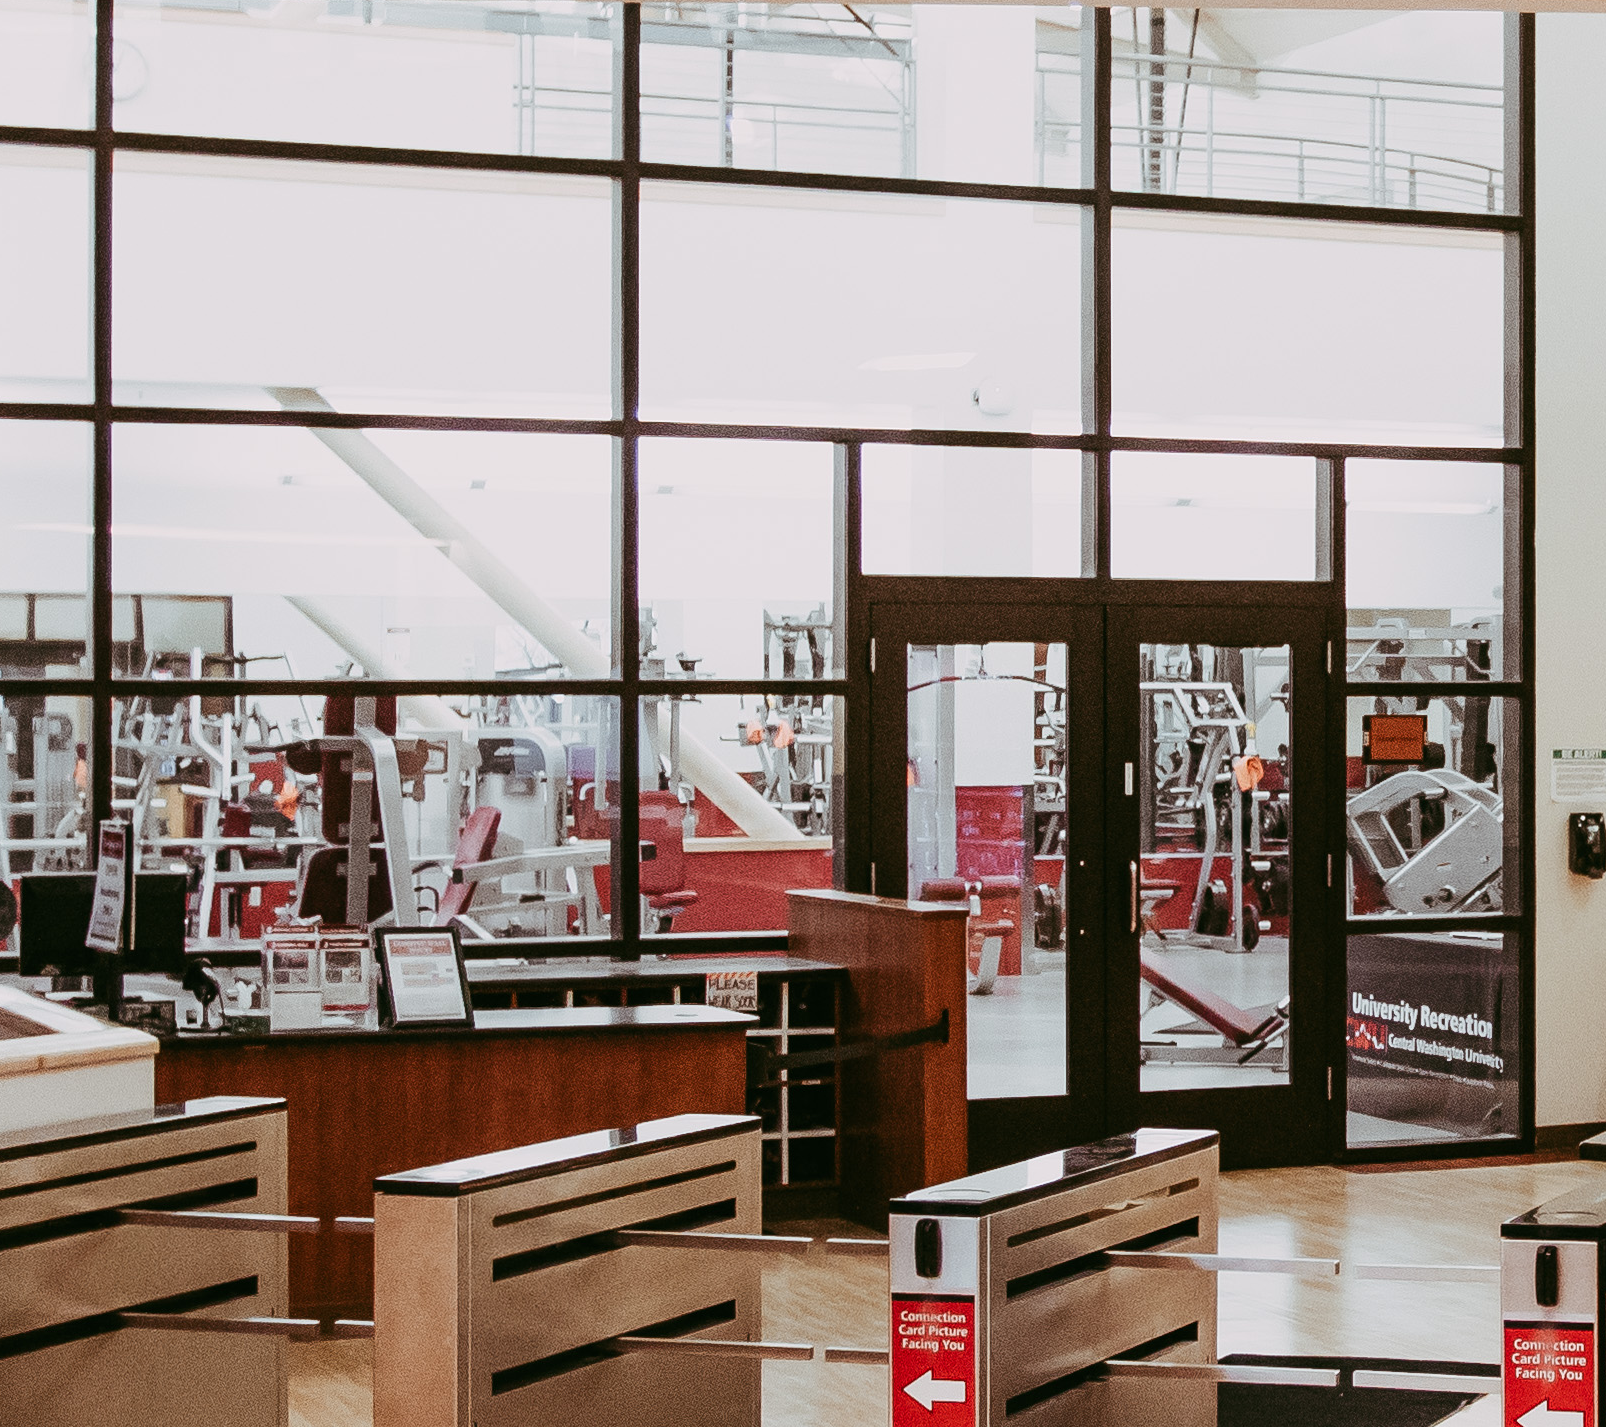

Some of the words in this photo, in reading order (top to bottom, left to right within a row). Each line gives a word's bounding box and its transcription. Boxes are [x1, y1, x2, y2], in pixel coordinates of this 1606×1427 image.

[709, 978, 755, 990] PLEASE
[1352, 991, 1418, 1030] University
[1420, 1005, 1493, 1039] Recreation
[1388, 1033, 1415, 1052] Central
[1416, 1039, 1464, 1062] Washington
[900, 1310, 966, 1323] Connection
[898, 1324, 925, 1335] Card
[928, 1325, 968, 1337] Picture
[902, 1338, 939, 1353] Facing
[942, 1339, 965, 1351] You
[1513, 1337, 1585, 1352] Connction
[1511, 1353, 1541, 1364] Card
[1544, 1354, 1587, 1367] Picture
[1515, 1367, 1555, 1382] Facing
[1559, 1368, 1583, 1381] You
